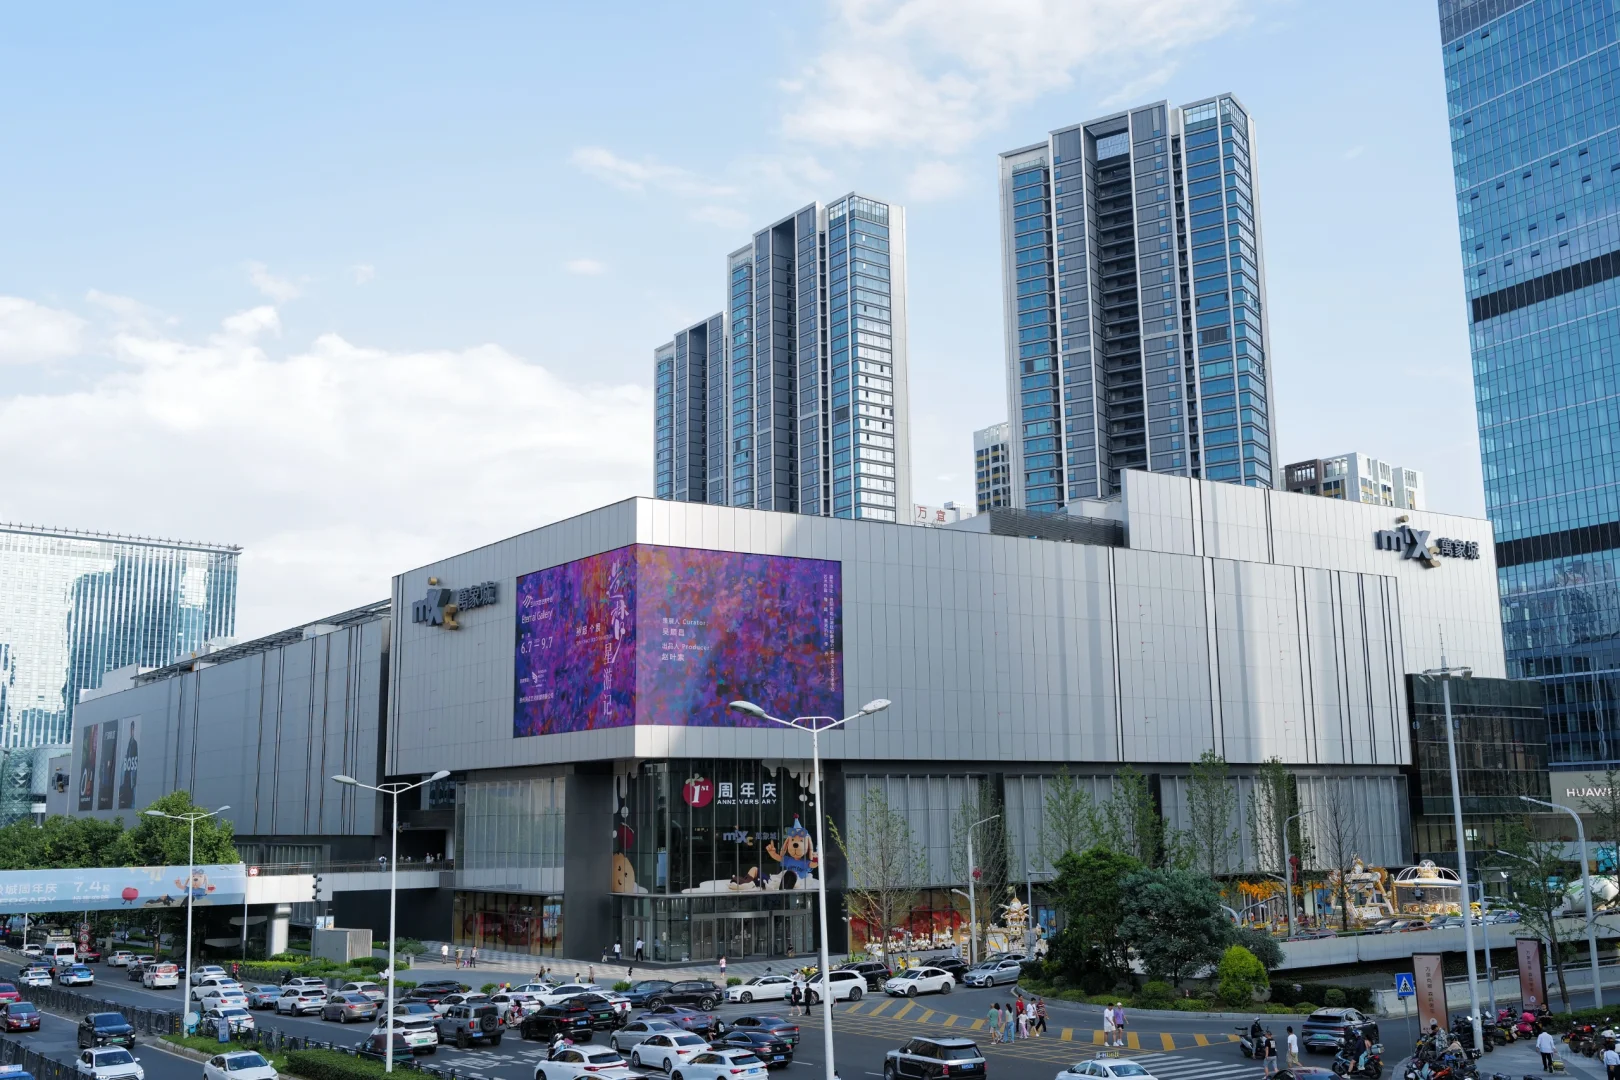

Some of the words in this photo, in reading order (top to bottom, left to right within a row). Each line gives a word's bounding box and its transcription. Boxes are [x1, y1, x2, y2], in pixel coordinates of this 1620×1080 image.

[521, 612, 537, 624] Eternal
[537, 607, 554, 621] Gallery
[661, 642, 680, 650] 出品人
[603, 643, 612, 715] 星游记
[123, 756, 138, 772] BOSS
[718, 782, 777, 798] 周年庆
